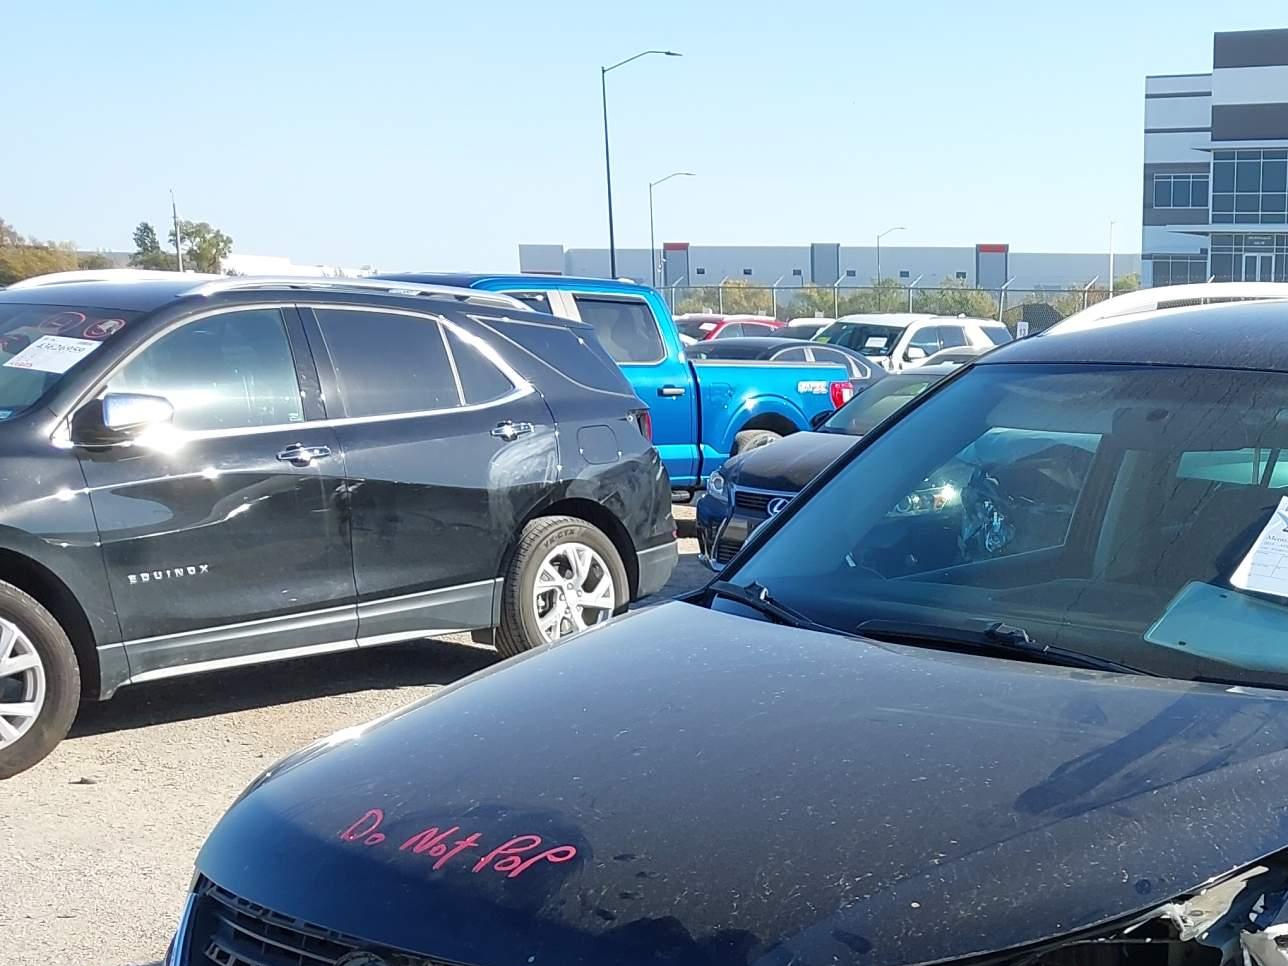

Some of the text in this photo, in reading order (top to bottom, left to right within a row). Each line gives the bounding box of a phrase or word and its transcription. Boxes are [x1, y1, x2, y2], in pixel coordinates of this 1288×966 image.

[127, 564, 209, 584] EQUINOX
[339, 807, 386, 846] Do
[399, 825, 483, 870] Not
